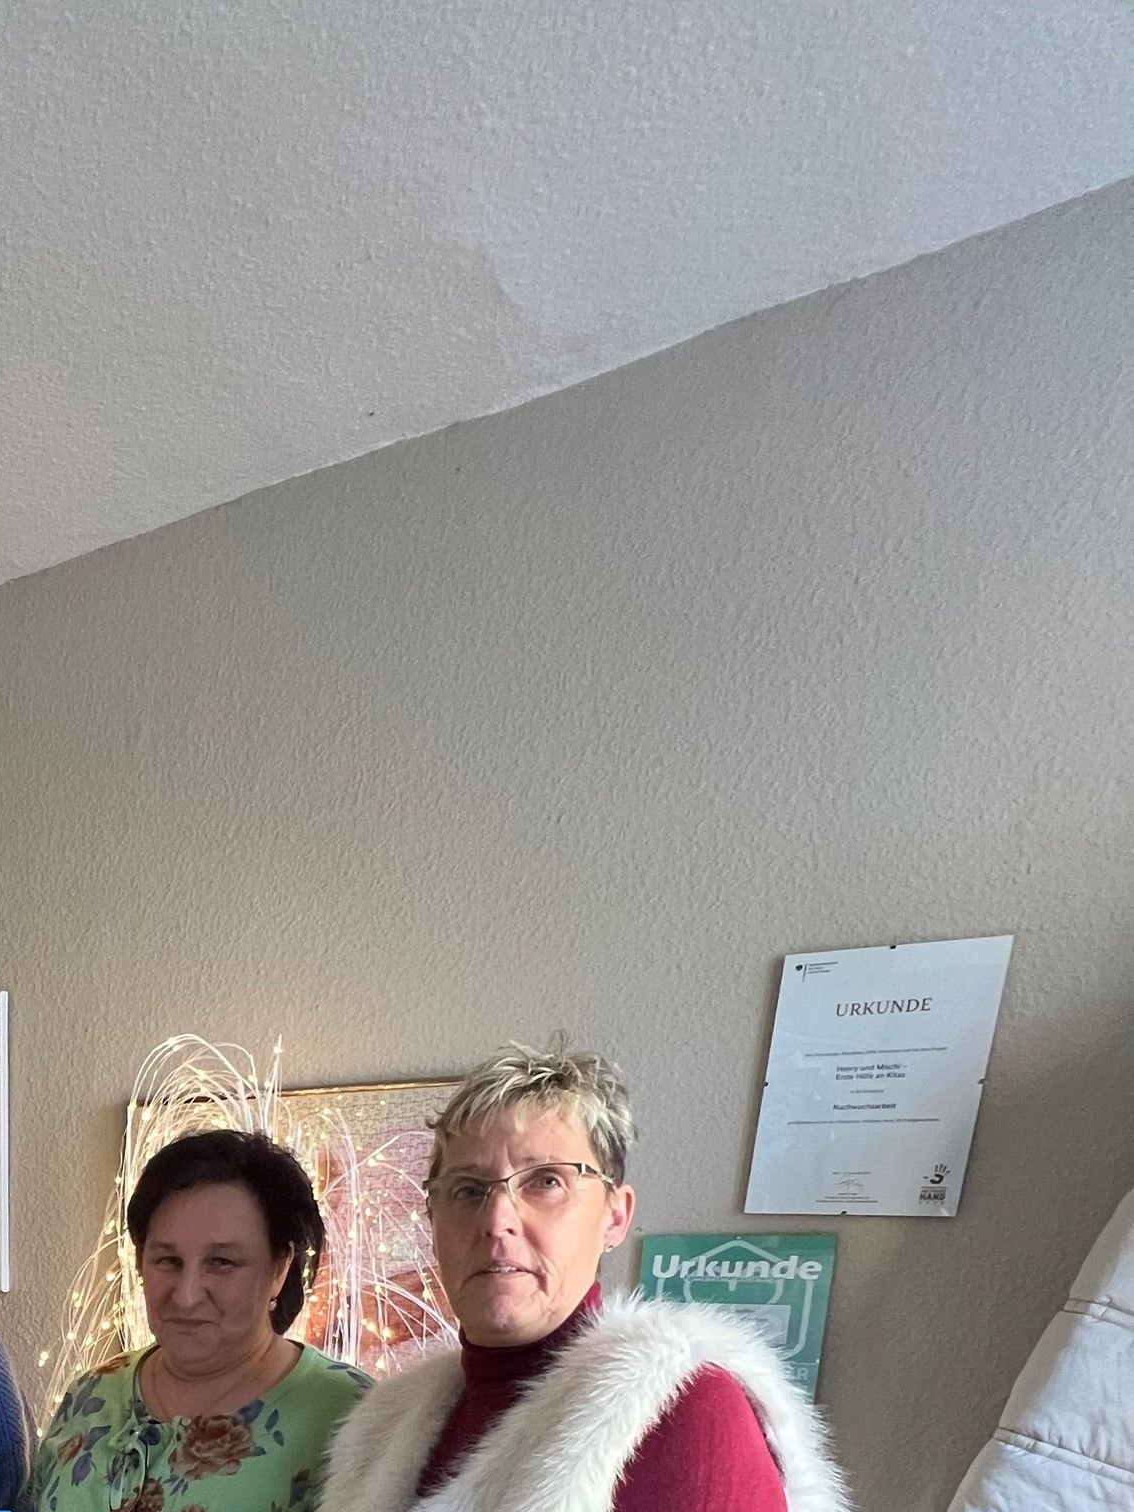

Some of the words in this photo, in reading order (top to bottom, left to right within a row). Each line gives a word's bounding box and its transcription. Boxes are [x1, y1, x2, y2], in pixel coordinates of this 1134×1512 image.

[835, 997, 933, 1017] URKUNDE
[835, 1073, 854, 1081] Erste
[651, 1254, 823, 1280] Urkunde
